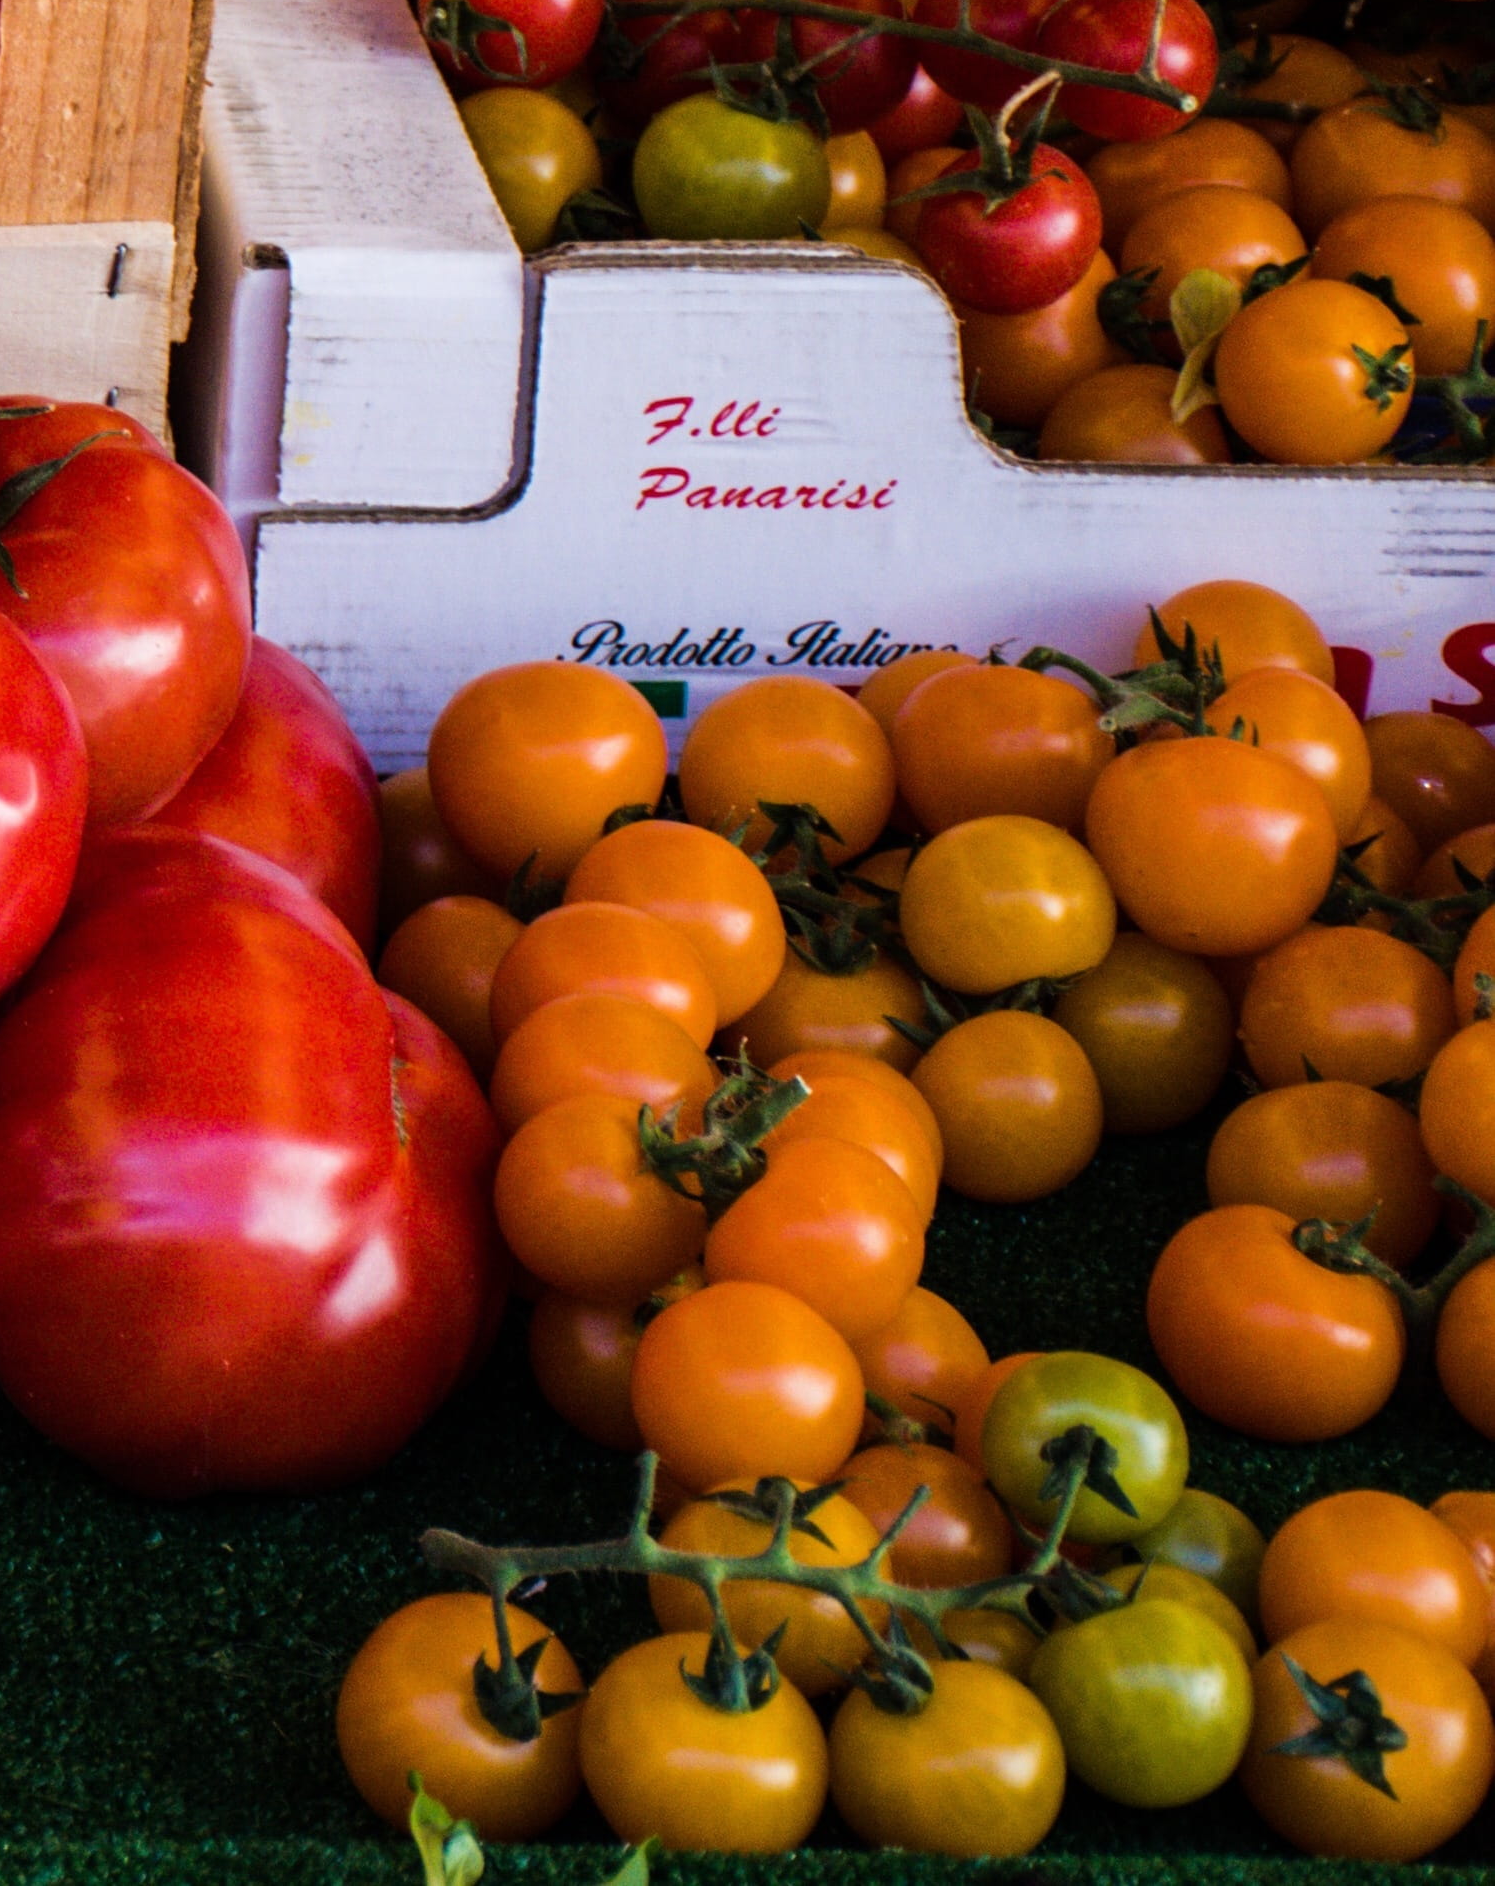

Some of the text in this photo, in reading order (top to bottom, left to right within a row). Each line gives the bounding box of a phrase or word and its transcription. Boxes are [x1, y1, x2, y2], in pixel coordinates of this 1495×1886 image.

[642, 396, 782, 446] F.lli
[635, 467, 898, 511] Panarisi
[556, 620, 756, 667] Prodotto
